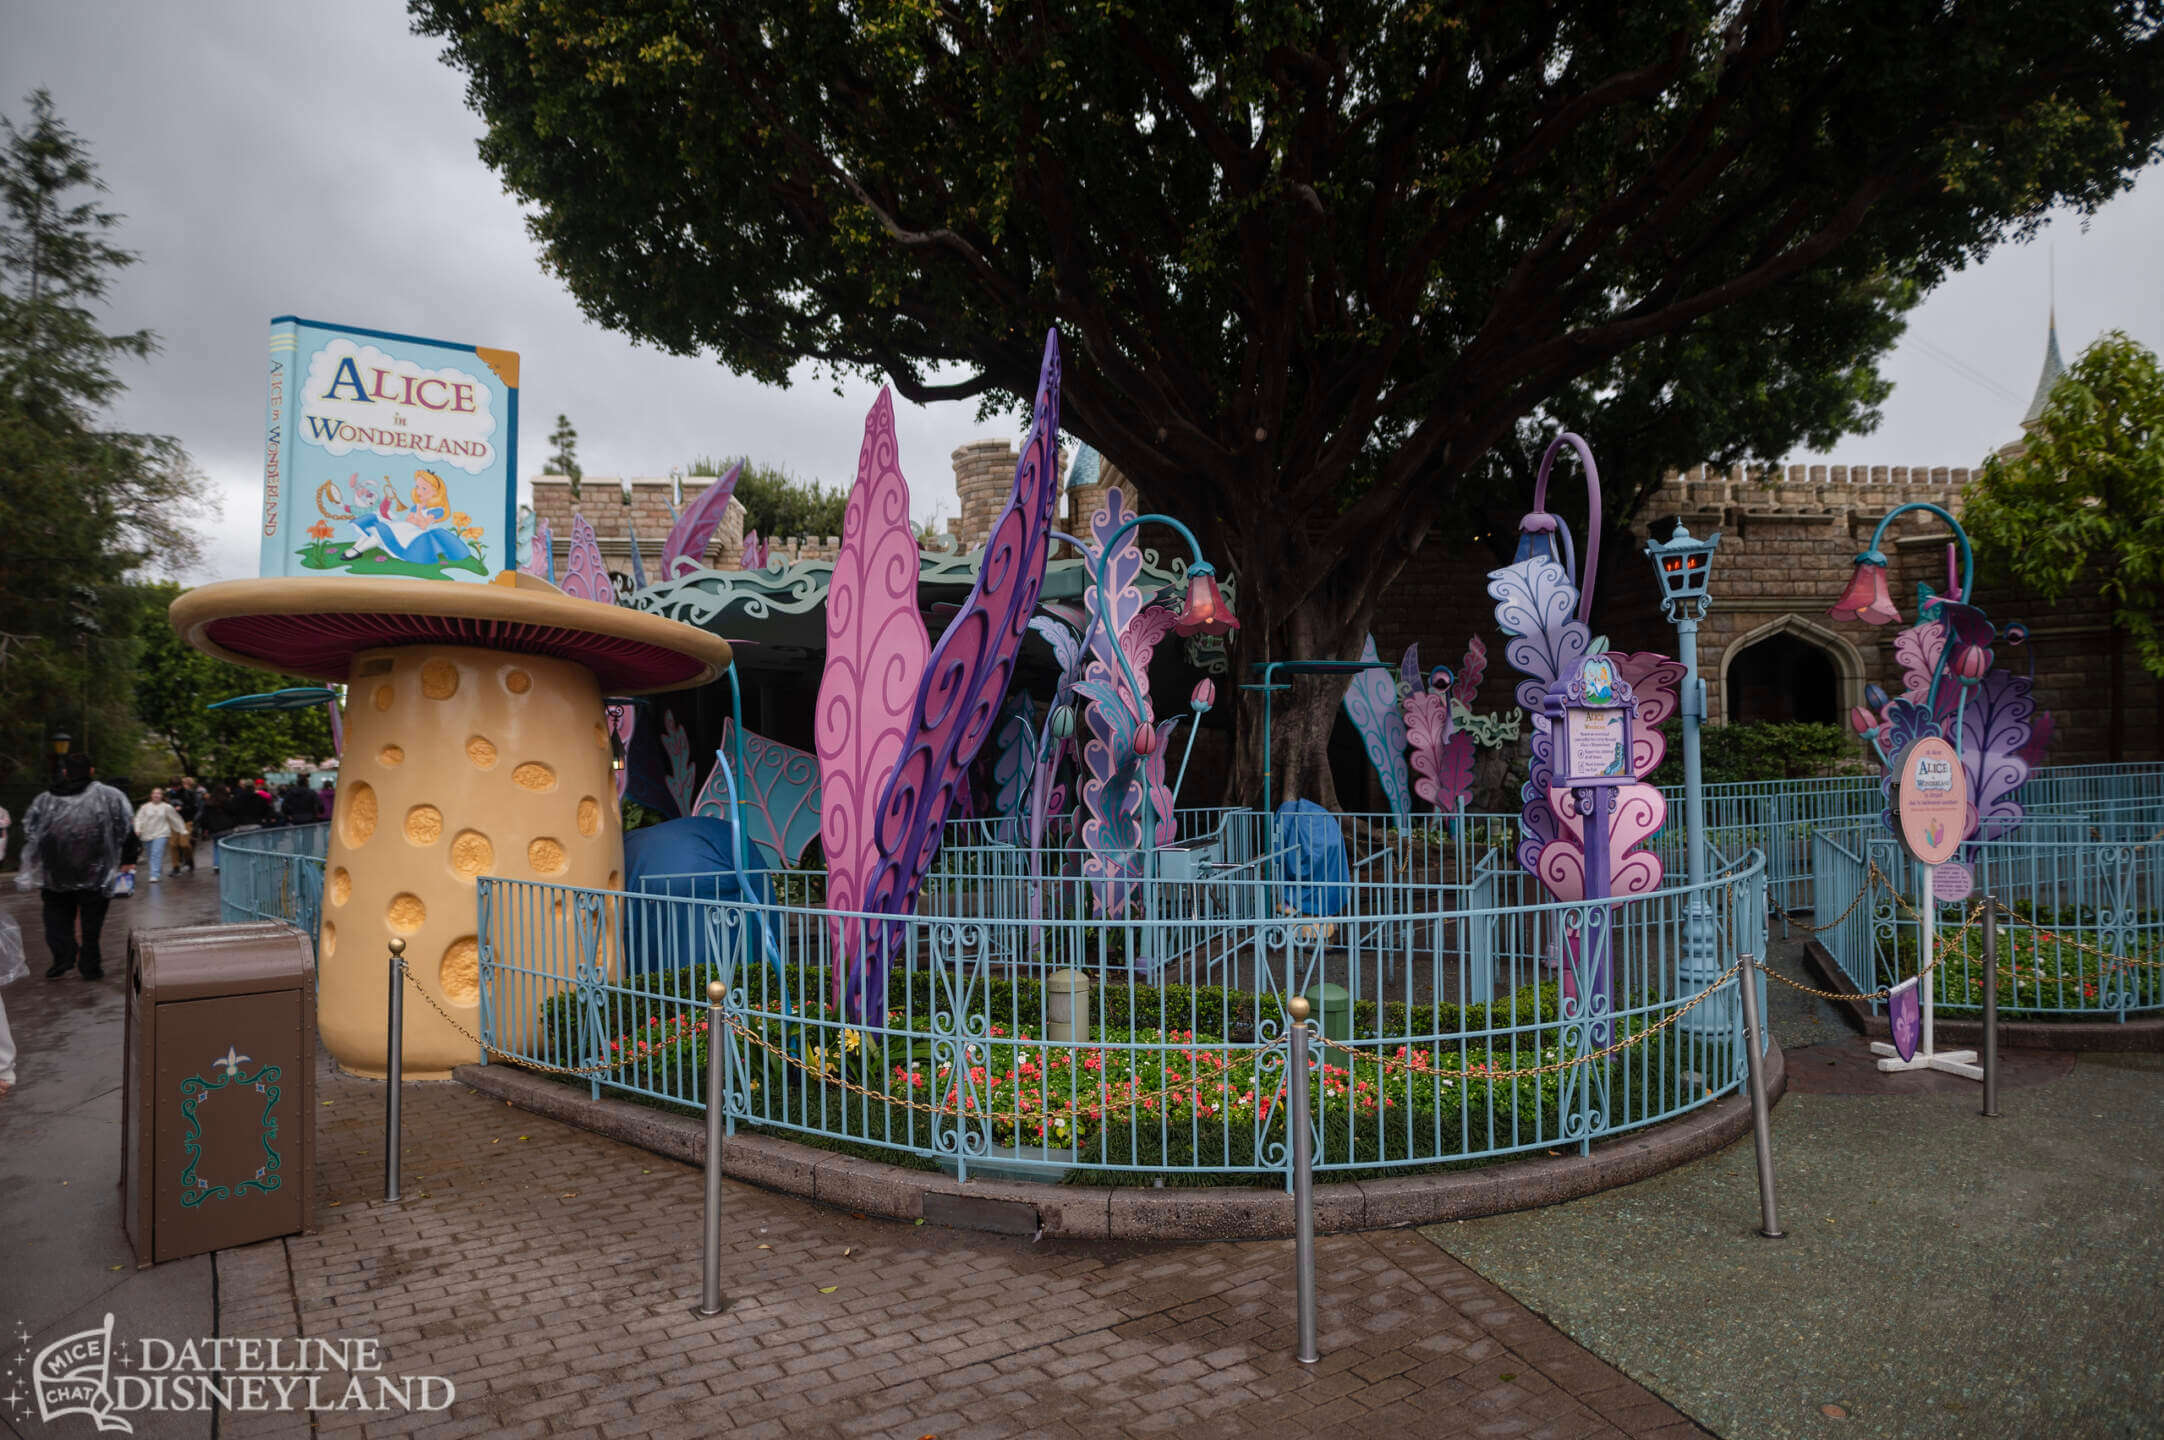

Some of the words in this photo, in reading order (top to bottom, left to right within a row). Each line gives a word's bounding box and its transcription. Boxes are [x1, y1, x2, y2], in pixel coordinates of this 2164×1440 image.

[269, 359, 284, 407] ALICE
[321, 356, 477, 413] ALICE
[271, 409, 281, 422] in
[306, 415, 488, 458] WONDERLAND
[394, 412, 407, 427] in
[264, 425, 281, 537] WONDERLAND
[1919, 760, 1949, 774] ALICE
